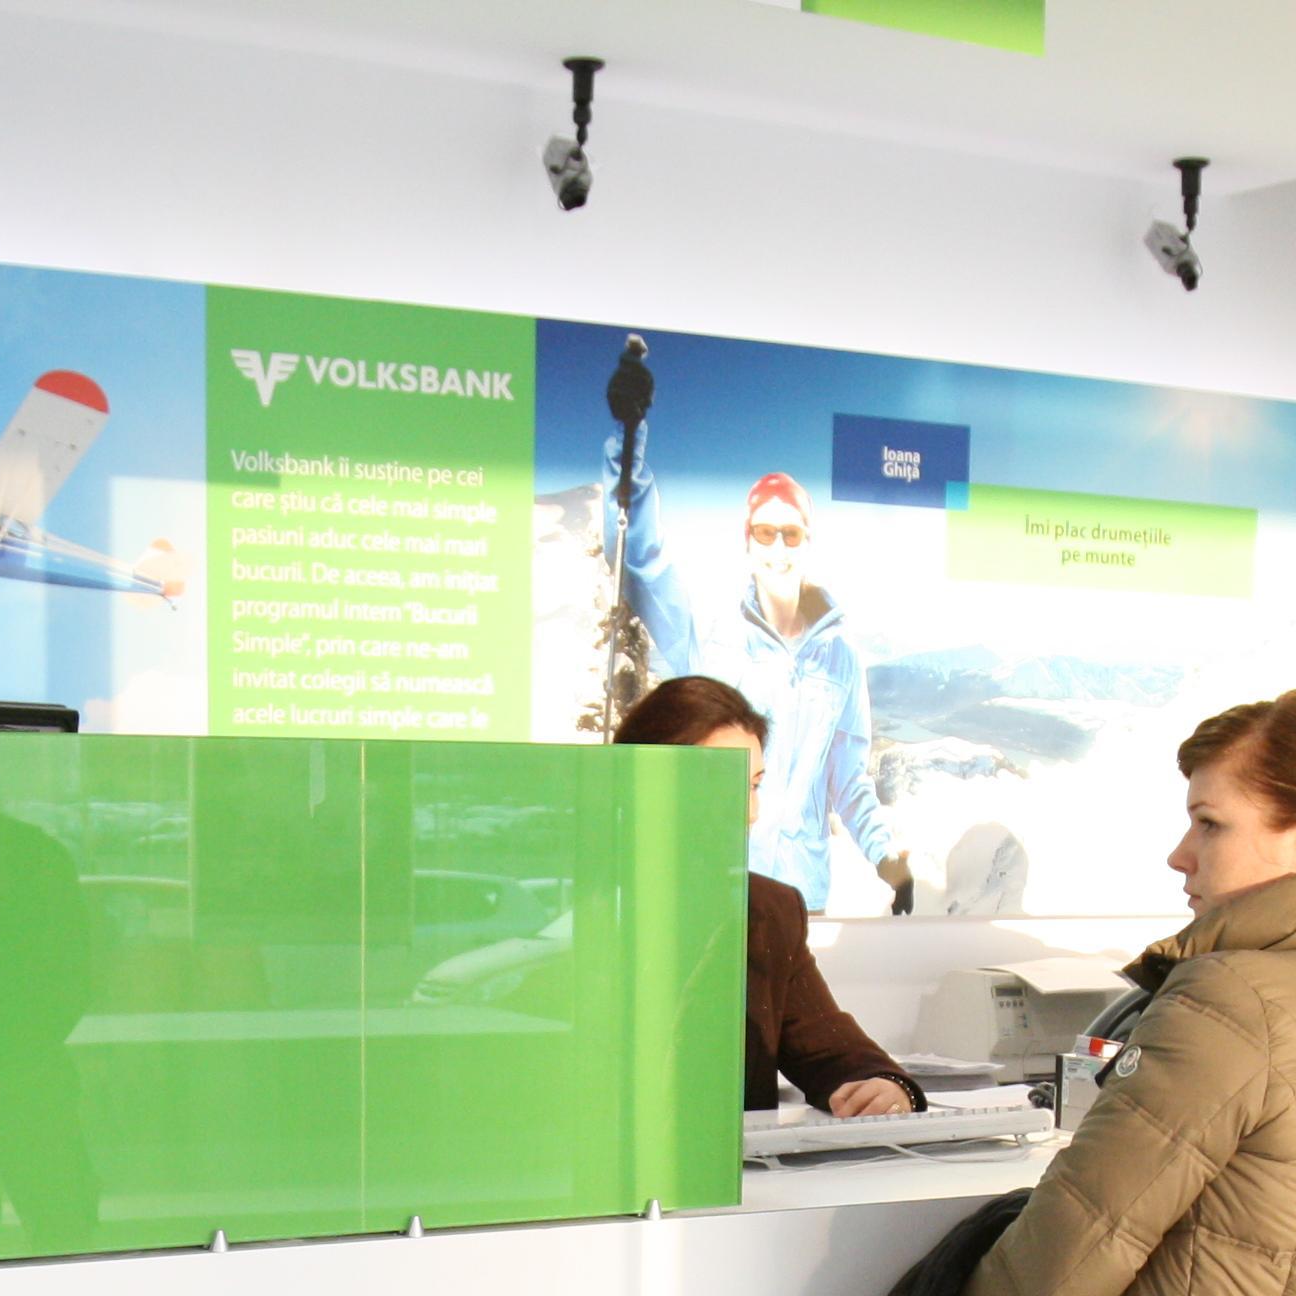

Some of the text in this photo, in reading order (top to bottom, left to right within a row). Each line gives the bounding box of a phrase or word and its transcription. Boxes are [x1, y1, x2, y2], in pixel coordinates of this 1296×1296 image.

[305, 354, 515, 402] VOLKSBANK
[883, 445, 921, 464] Ioana
[231, 450, 335, 477] Volksbank
[339, 457, 350, 478] îi
[427, 466, 452, 489] pe
[456, 466, 484, 487] cei
[231, 491, 275, 510] care
[320, 493, 343, 513] că
[348, 496, 388, 517] cele
[392, 498, 429, 518] mai
[432, 502, 497, 525] simple
[231, 525, 488, 557] pasiuni aduc cele mai mari
[1025, 514, 1050, 535] Îmi
[1054, 520, 1086, 541] plac
[1061, 549, 1136, 567] pe munte
[231, 559, 306, 583] bucurii.
[311, 563, 340, 585] De
[408, 571, 441, 589] am
[231, 599, 339, 623] programul
[344, 603, 402, 622] intern
[316, 635, 355, 659] prin
[360, 638, 401, 657] care
[406, 641, 469, 660] ne-am
[232, 668, 297, 689] invitat
[300, 668, 367, 697] colegii
[370, 671, 391, 692] să
[232, 703, 489, 732] acele lucruri simple care le
